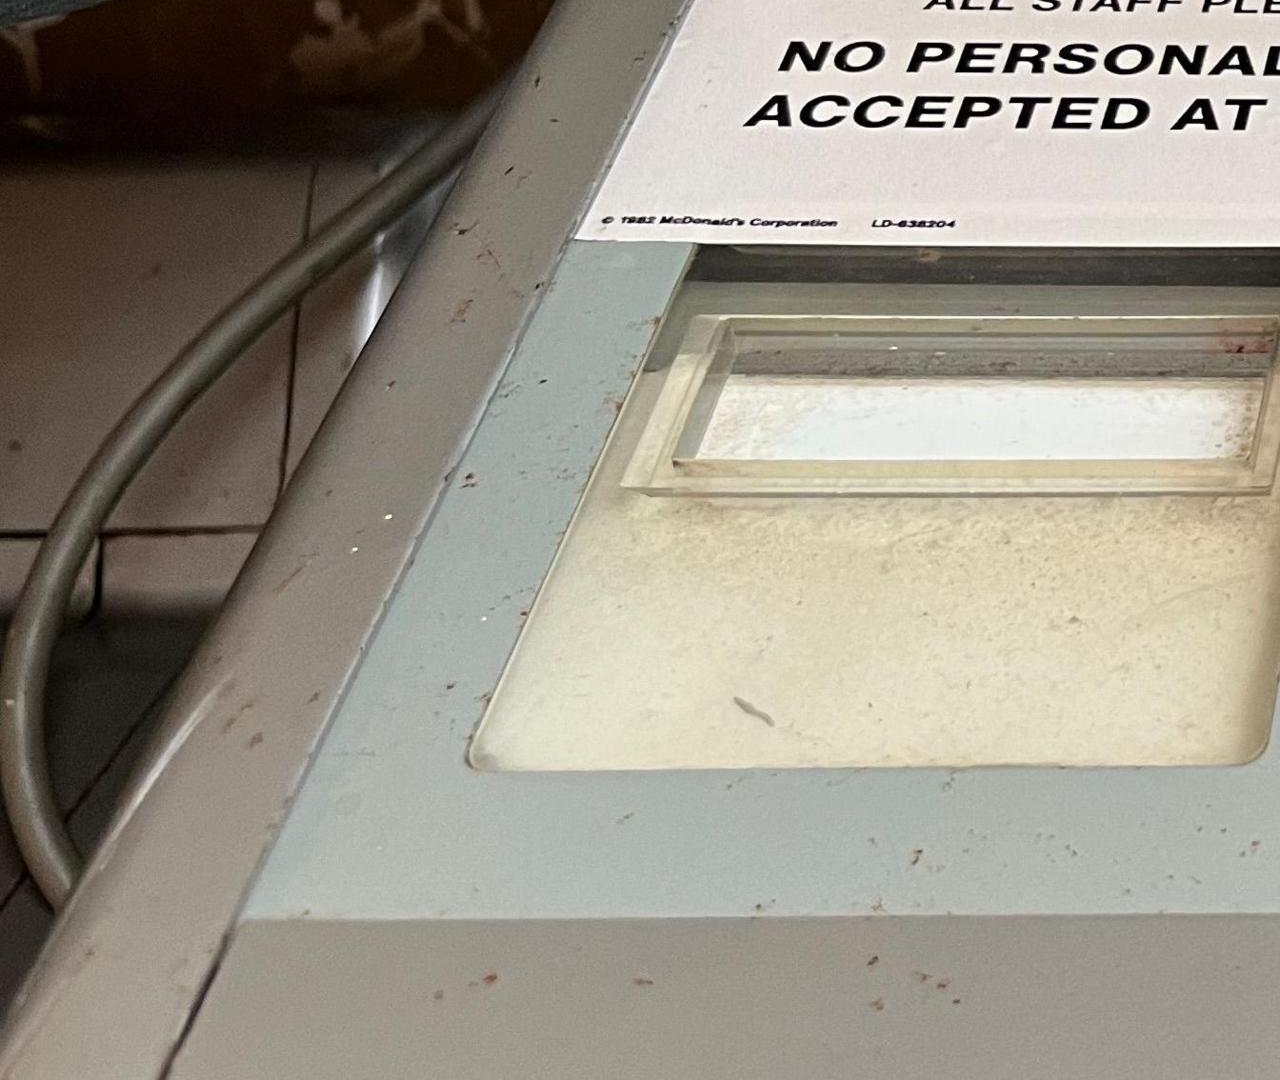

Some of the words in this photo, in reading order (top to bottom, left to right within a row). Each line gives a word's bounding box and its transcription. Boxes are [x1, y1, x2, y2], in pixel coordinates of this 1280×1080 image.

[777, 41, 885, 73] NO
[742, 94, 1151, 130] ACCEPTED
[1170, 98, 1268, 131] AT
[659, 215, 745, 227] McDonald's
[749, 217, 838, 228] Corporation
